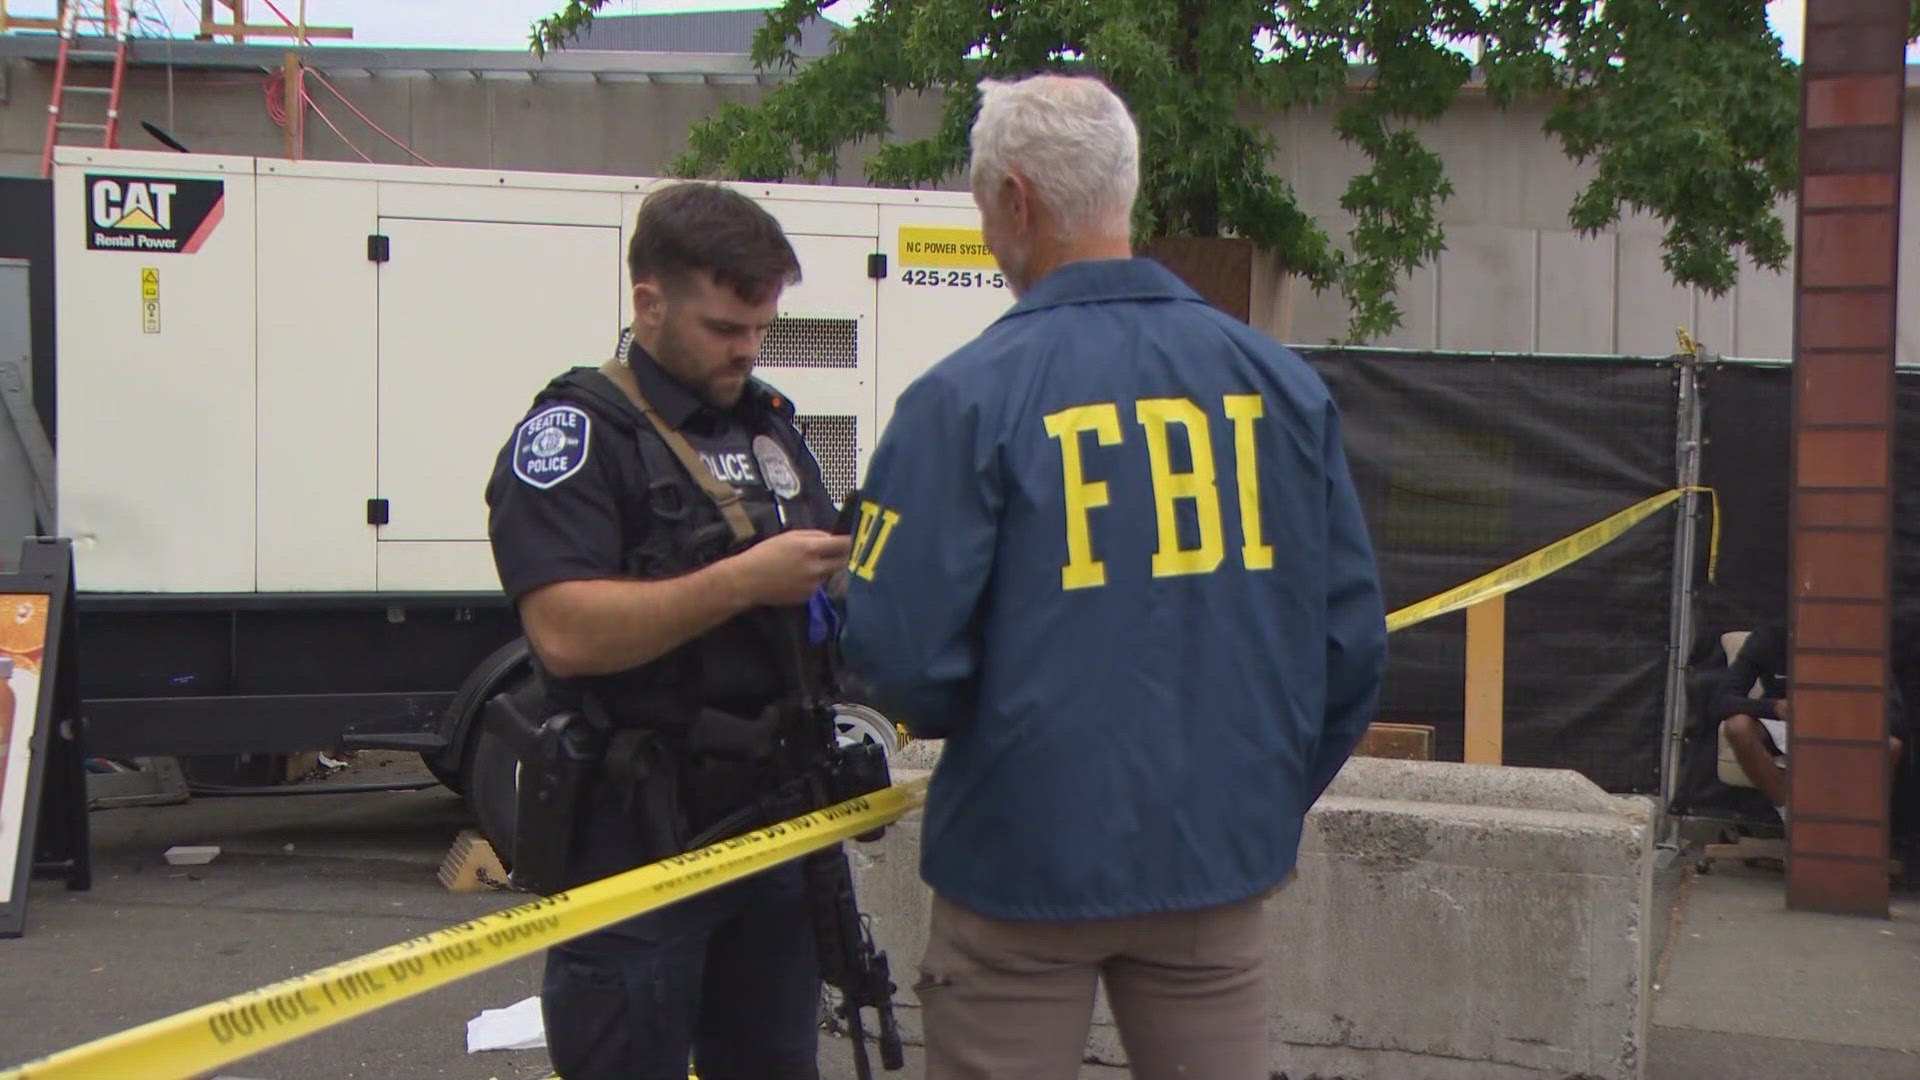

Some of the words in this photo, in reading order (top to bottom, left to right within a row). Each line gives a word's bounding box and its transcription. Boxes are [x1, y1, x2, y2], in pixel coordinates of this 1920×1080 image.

[93, 180, 177, 230] CAT
[95, 233, 134, 247] Rental
[138, 235, 176, 249] Power
[906, 242, 921, 253] NC
[924, 243, 957, 254] POWER
[901, 270, 1009, 288] 425-251-5
[527, 412, 577, 436] SEATTLE
[526, 456, 569, 474] POLICE
[699, 452, 754, 481] OLICE
[1043, 395, 1273, 590] FBI
[848, 501, 900, 581] BI
